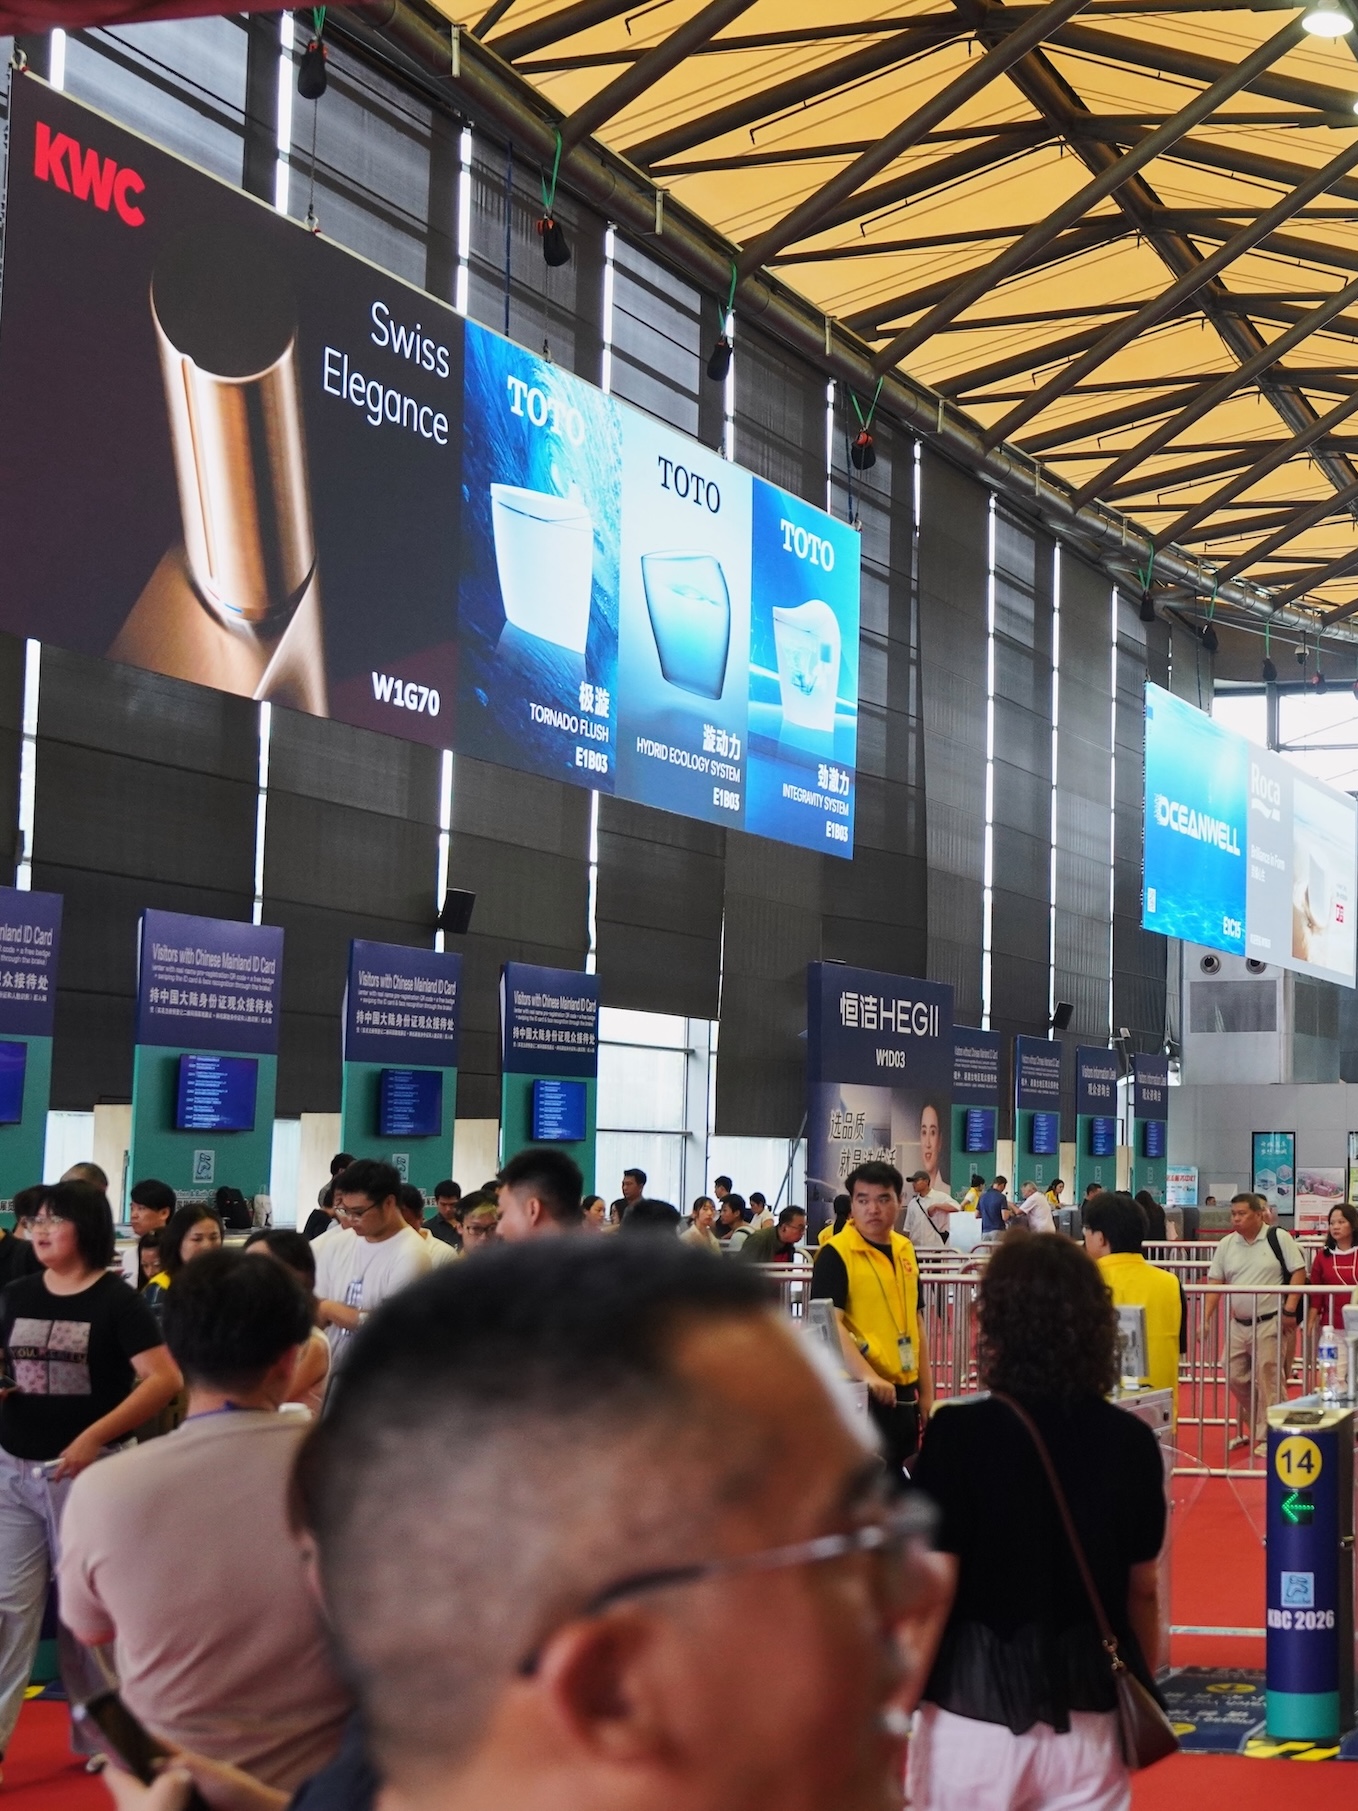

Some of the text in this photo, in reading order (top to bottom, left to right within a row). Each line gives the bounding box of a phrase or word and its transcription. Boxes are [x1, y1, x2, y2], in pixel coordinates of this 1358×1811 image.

[34, 121, 145, 227] KWC
[371, 302, 449, 378] Swiss
[323, 346, 448, 445] Elegance
[507, 375, 585, 446] TOTO
[658, 455, 721, 514] TOTO
[780, 518, 834, 572] TOTO
[372, 671, 440, 716] W1G70
[530, 703, 609, 743] TORNADO FLUSH
[576, 746, 608, 773] E1B03
[669, 747, 710, 773] ECOLOGY
[710, 761, 740, 783] SYSTEM
[713, 787, 740, 811] E1B03
[1251, 763, 1280, 805] Roca
[824, 796, 849, 816] SYSTEM
[826, 821, 848, 842] E1B03
[1154, 793, 1240, 856] OCEANWELL
[23, 925, 32, 944] ID
[34, 926, 53, 946] Card
[152, 943, 276, 974] Visitors with Chinese Mainland ID Card
[359, 970, 379, 987] Visitors
[393, 974, 413, 991] Chinese
[414, 977, 437, 994] Mainland
[444, 980, 456, 995] Card
[150, 987, 273, 1014] 持中国大陆身份证观众接待处
[356, 1010, 454, 1031] 持中国大陆身份证观众接待处
[876, 1048, 906, 1068] W1D03
[829, 1110, 866, 1141] 选品质
[1281, 1449, 1315, 1474] 14
[1294, 1609, 1335, 1630] 2026
